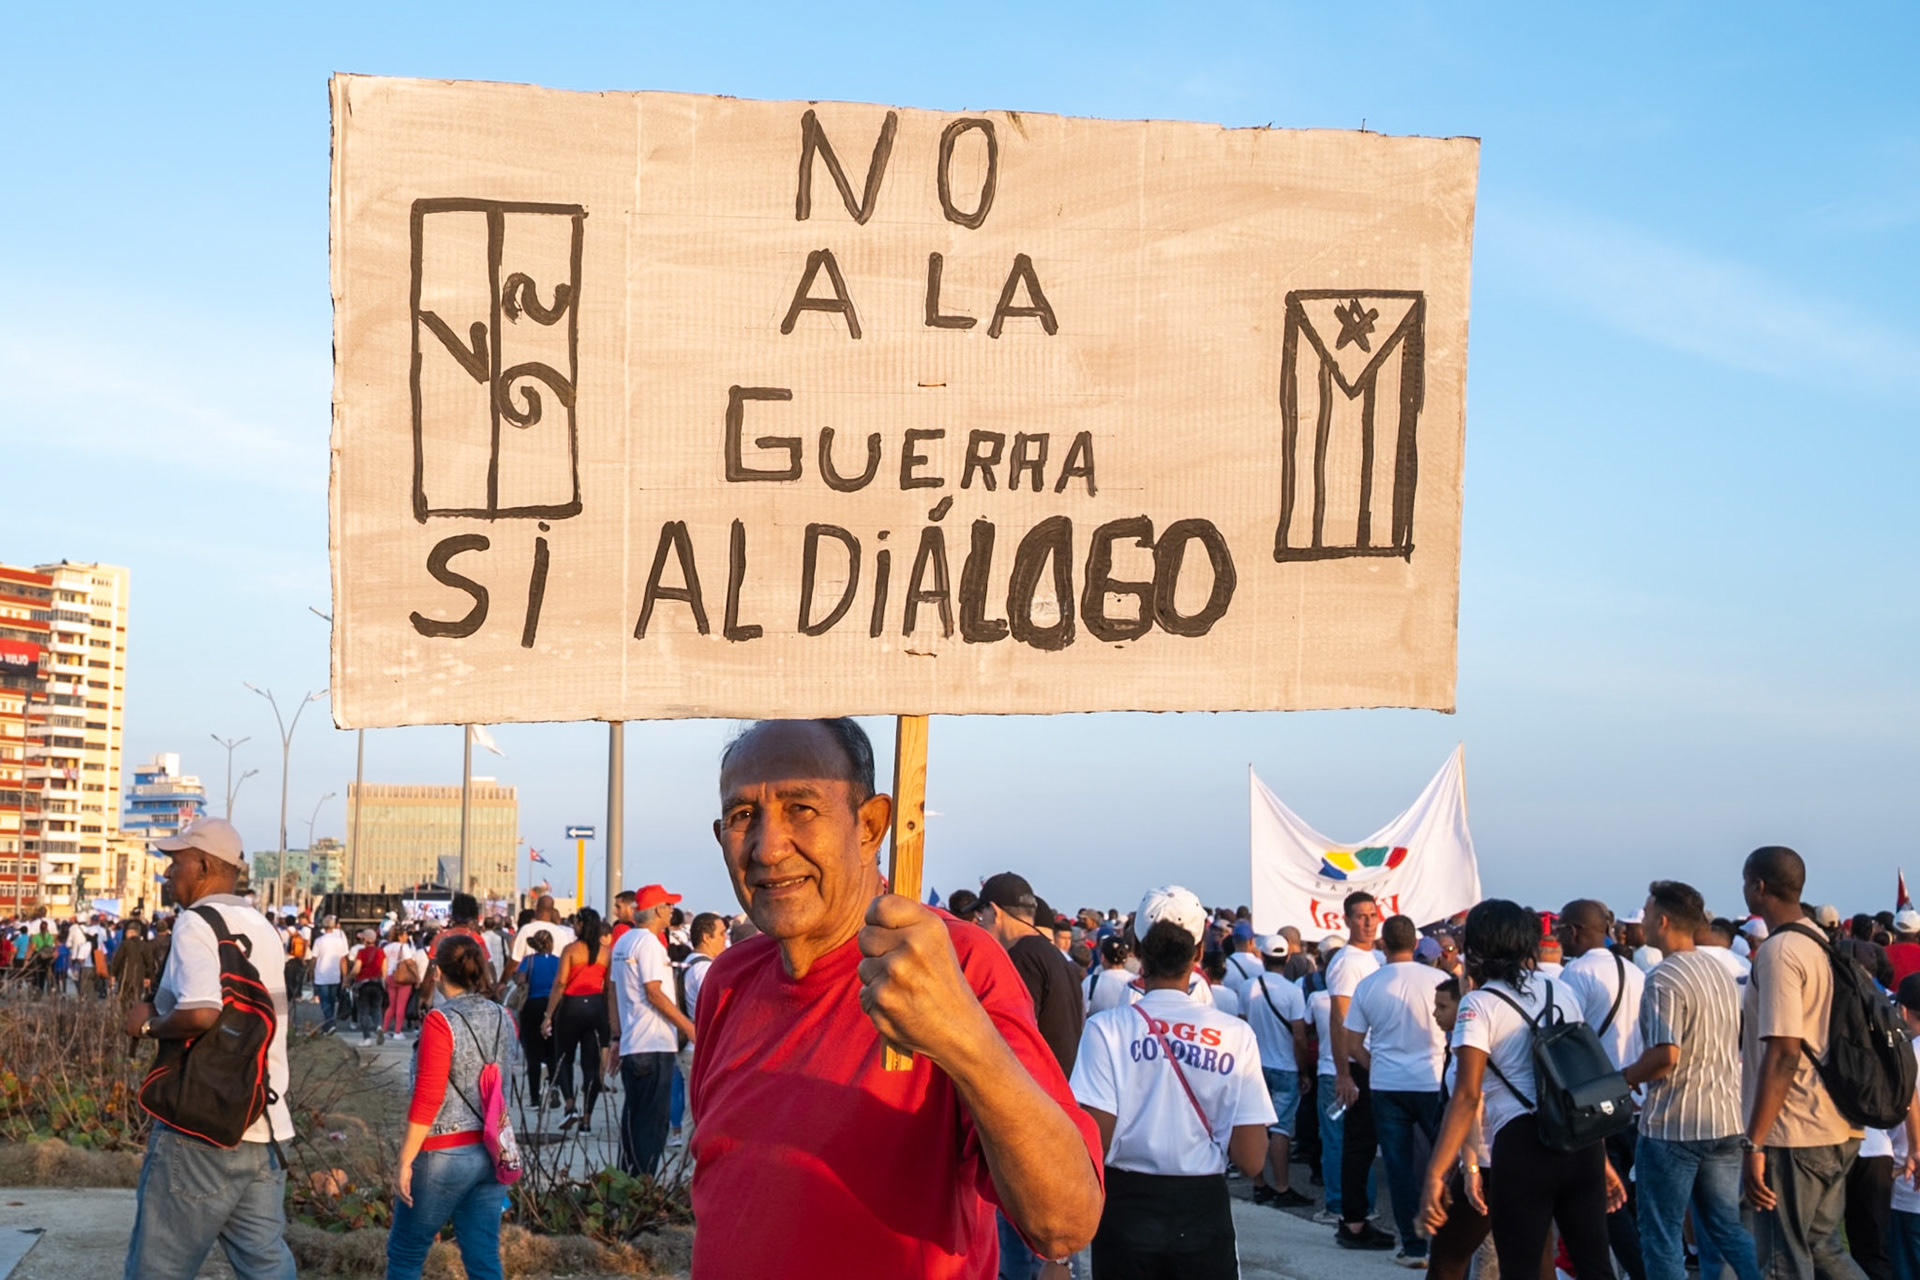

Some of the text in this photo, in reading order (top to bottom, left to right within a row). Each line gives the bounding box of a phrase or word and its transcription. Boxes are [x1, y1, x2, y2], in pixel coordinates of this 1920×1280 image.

[796, 110, 997, 229] NO
[781, 249, 1058, 339] A LA
[725, 386, 1097, 497] GUERRA
[634, 519, 762, 642] AL
